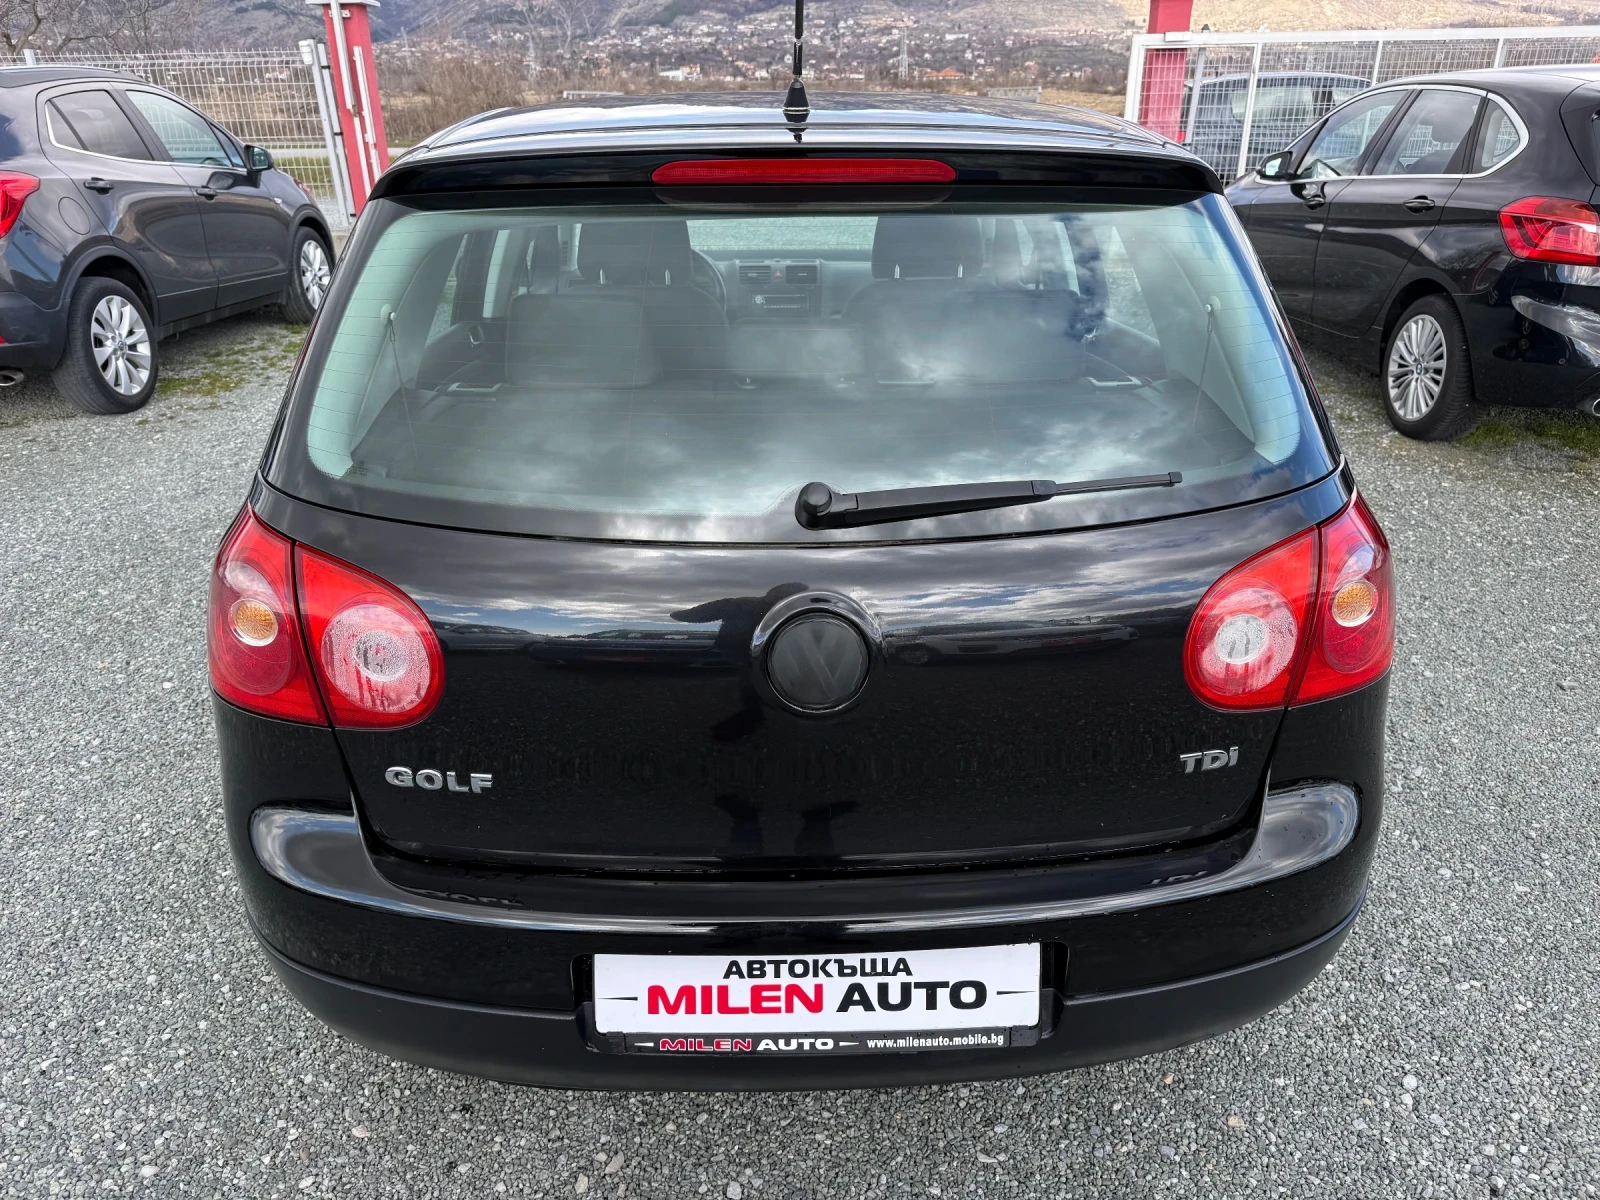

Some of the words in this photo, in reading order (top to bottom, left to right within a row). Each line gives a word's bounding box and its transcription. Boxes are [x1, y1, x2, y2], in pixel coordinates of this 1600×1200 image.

[385, 766, 493, 794] GOLF
[647, 983, 824, 1015] MILEN
[836, 980, 988, 1012] AUTO
[659, 1038, 752, 1052] MILEN
[756, 1038, 834, 1051] AUTO
[866, 1033, 1004, 1049] www.milenauto.mobile.bg
